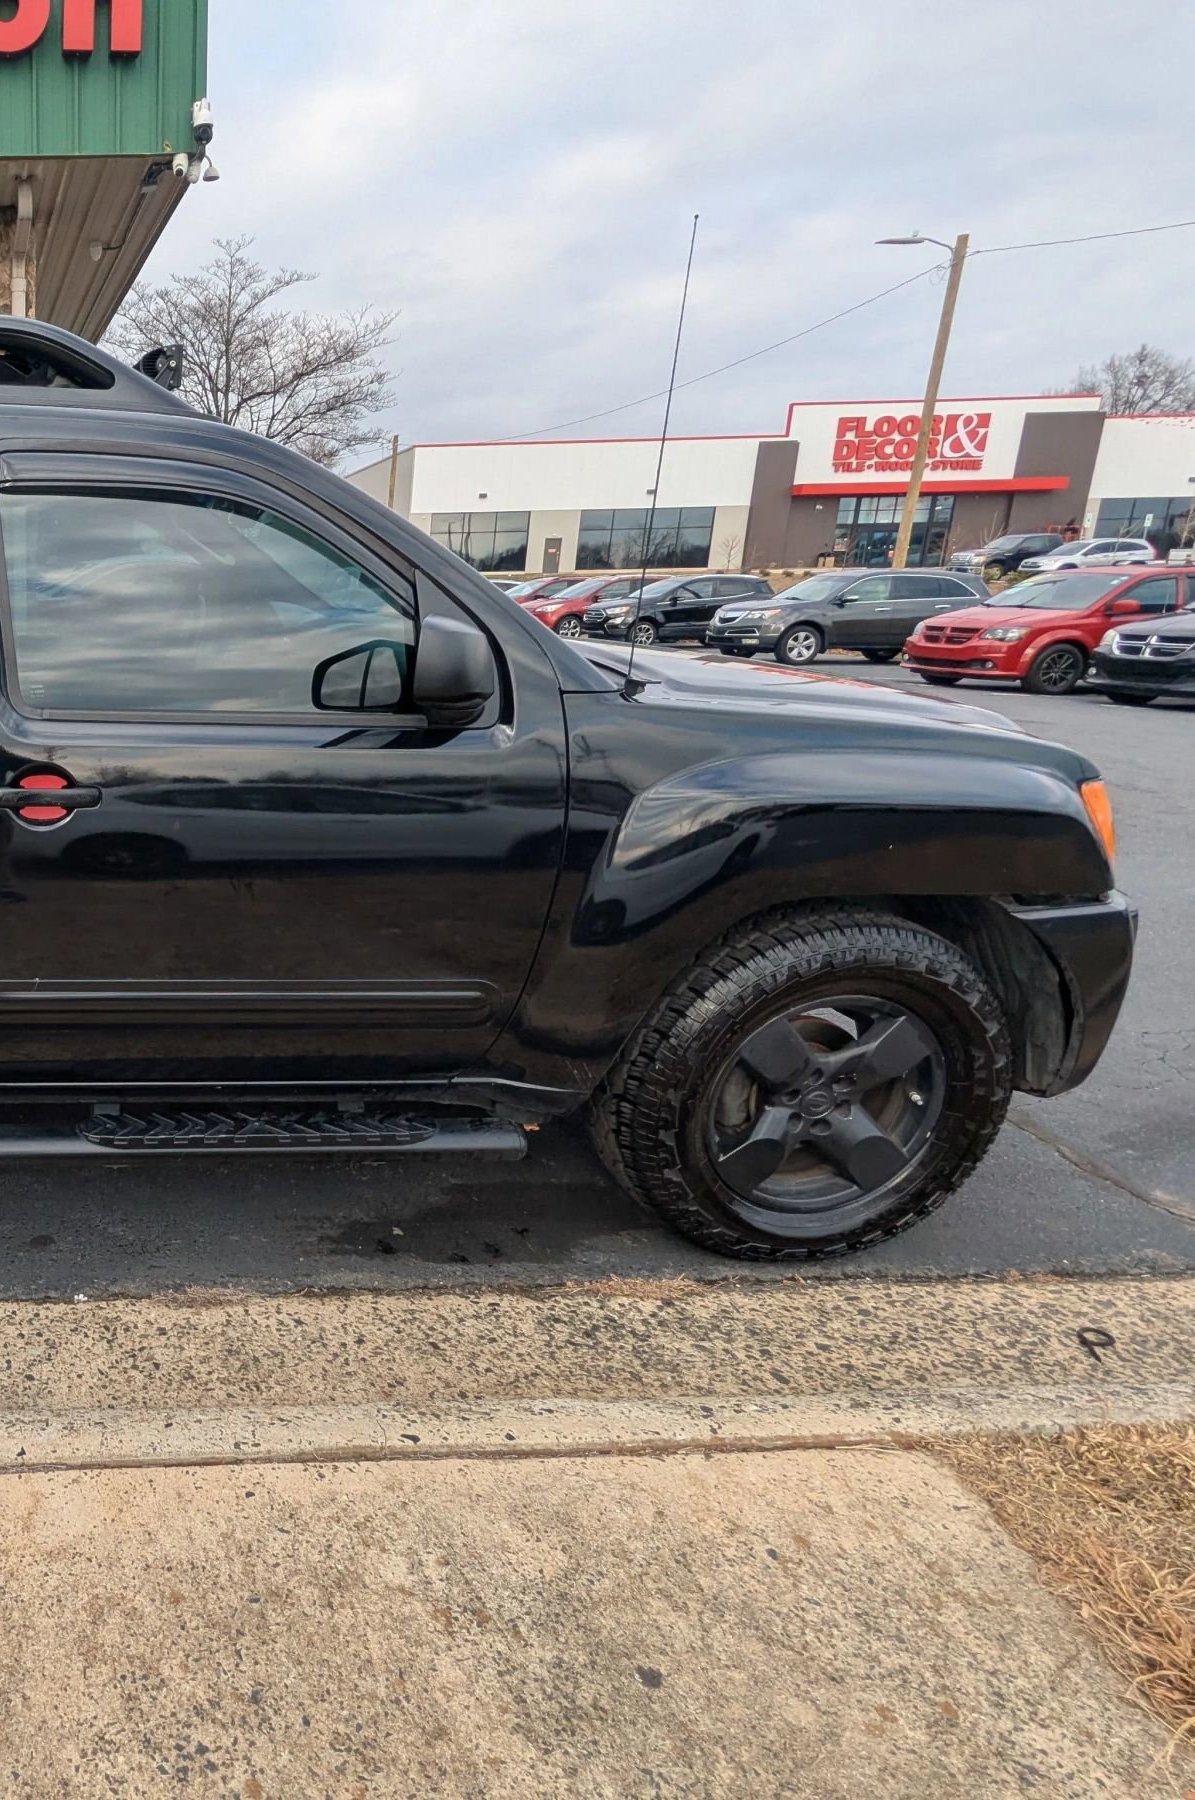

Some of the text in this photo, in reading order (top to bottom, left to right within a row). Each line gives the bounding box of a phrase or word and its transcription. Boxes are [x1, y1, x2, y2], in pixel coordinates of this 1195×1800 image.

[832, 459, 984, 473] TILE WOO STONE
